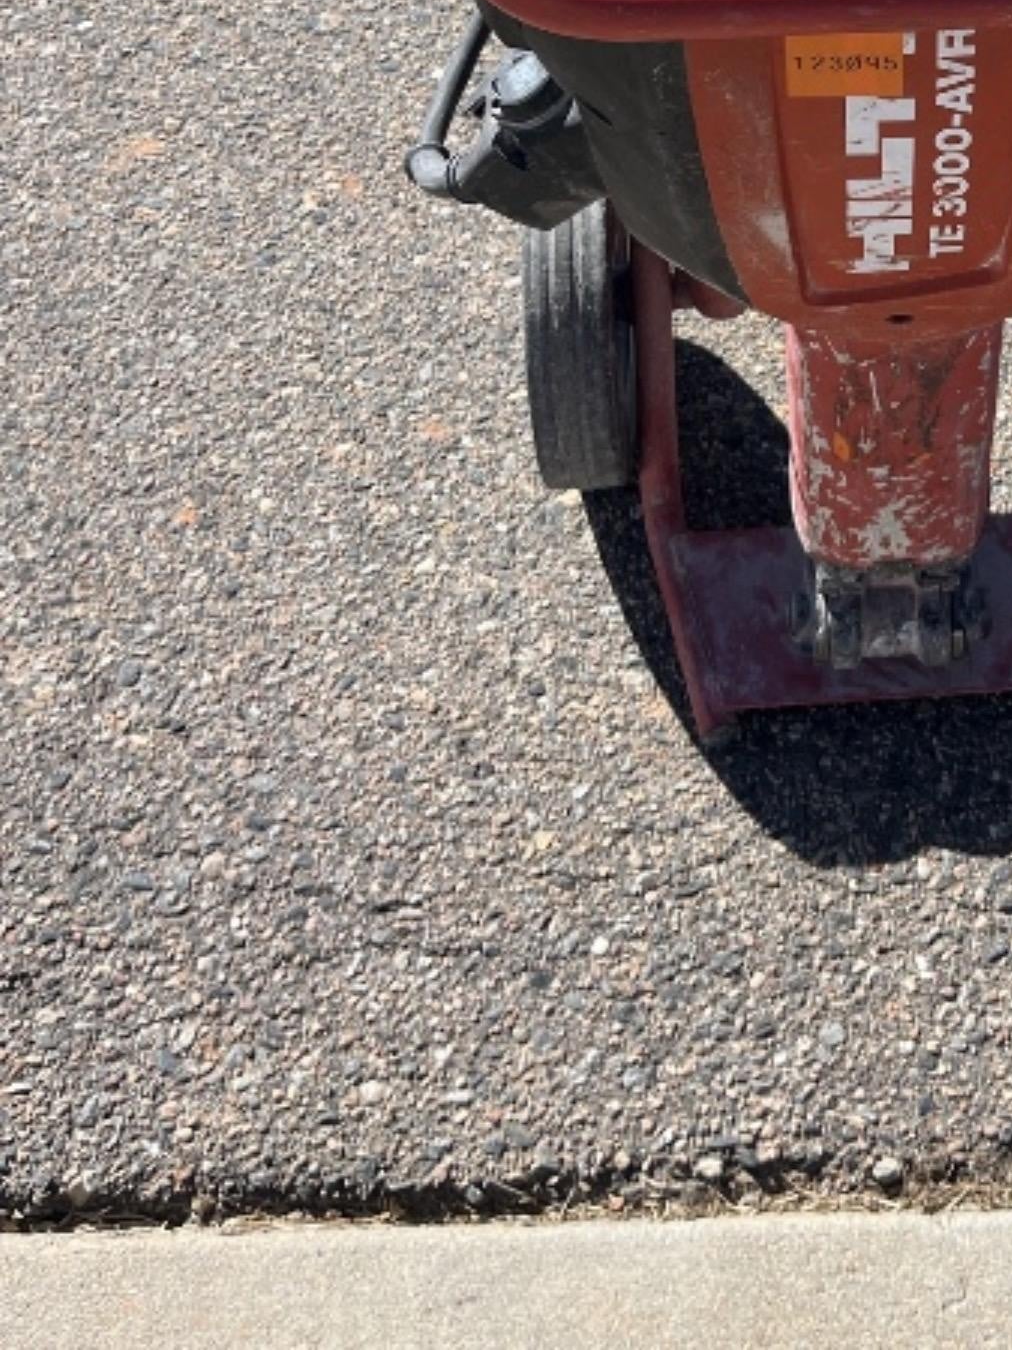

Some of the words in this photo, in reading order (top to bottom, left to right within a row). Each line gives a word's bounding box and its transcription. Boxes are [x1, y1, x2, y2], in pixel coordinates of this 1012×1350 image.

[845, 31, 915, 274] HILT
[933, 29, 976, 217] 3000-AVR
[929, 224, 964, 258] TE
